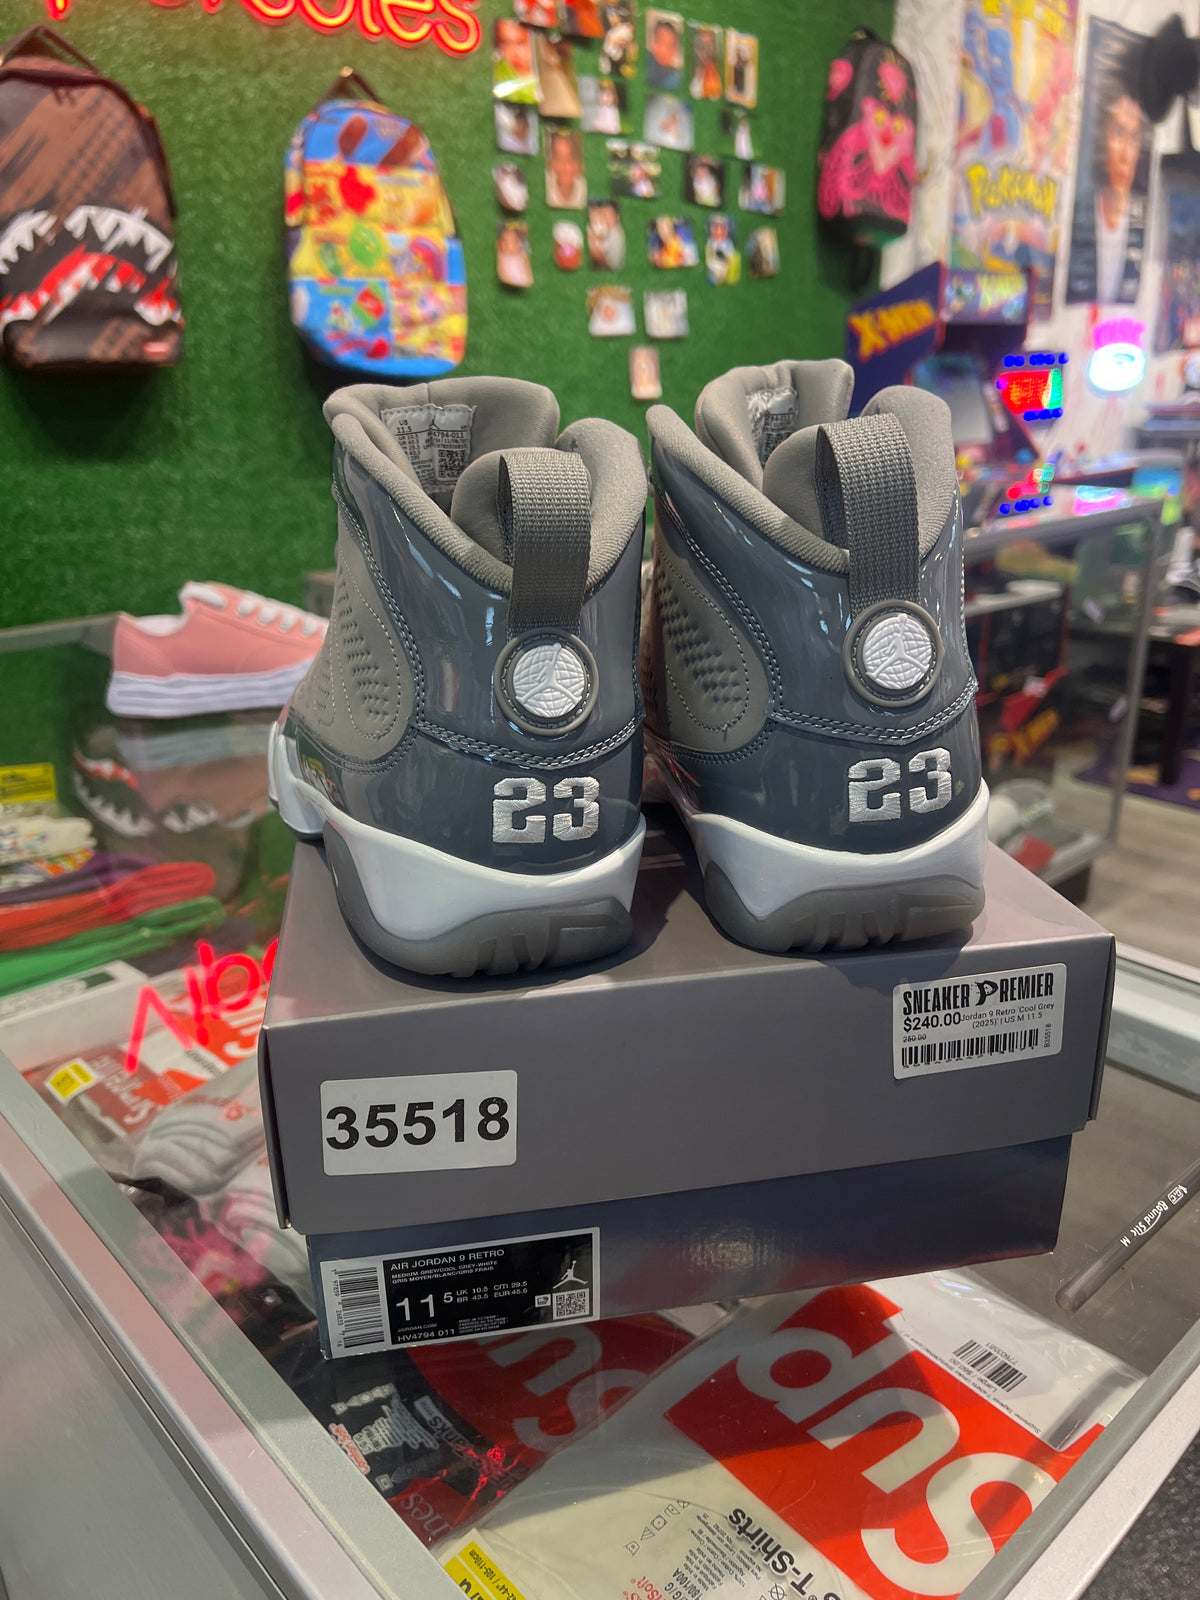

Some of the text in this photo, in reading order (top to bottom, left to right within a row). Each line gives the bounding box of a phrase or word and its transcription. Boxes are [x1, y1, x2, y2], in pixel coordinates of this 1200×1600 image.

[848, 746, 952, 823] 23
[492, 776, 600, 844] 23
[903, 984, 970, 1016] SNEAKER
[960, 1012, 987, 1021] Jordan
[995, 1008, 1016, 1016] Retro
[1038, 1003, 1054, 1011] Grey
[903, 1012, 961, 1033] $240.00
[1004, 1016, 1015, 1024] US
[1027, 1012, 1043, 1020] 11.5
[326, 1096, 510, 1150] 35518
[1144, 1200, 1169, 1226] Round
[391, 1262, 409, 1271] AIR
[412, 1256, 456, 1268] JORDAN
[469, 1249, 504, 1260] RETRO
[392, 1260, 498, 1279] MEDIUM GREY/COOL GREY-WHITE
[494, 1290, 510, 1298] EUR
[396, 1294, 434, 1321] 11
[443, 1292, 453, 1303] 5
[398, 1331, 434, 1342] HV4794
[727, 1507, 819, 1597] T-Shirts
